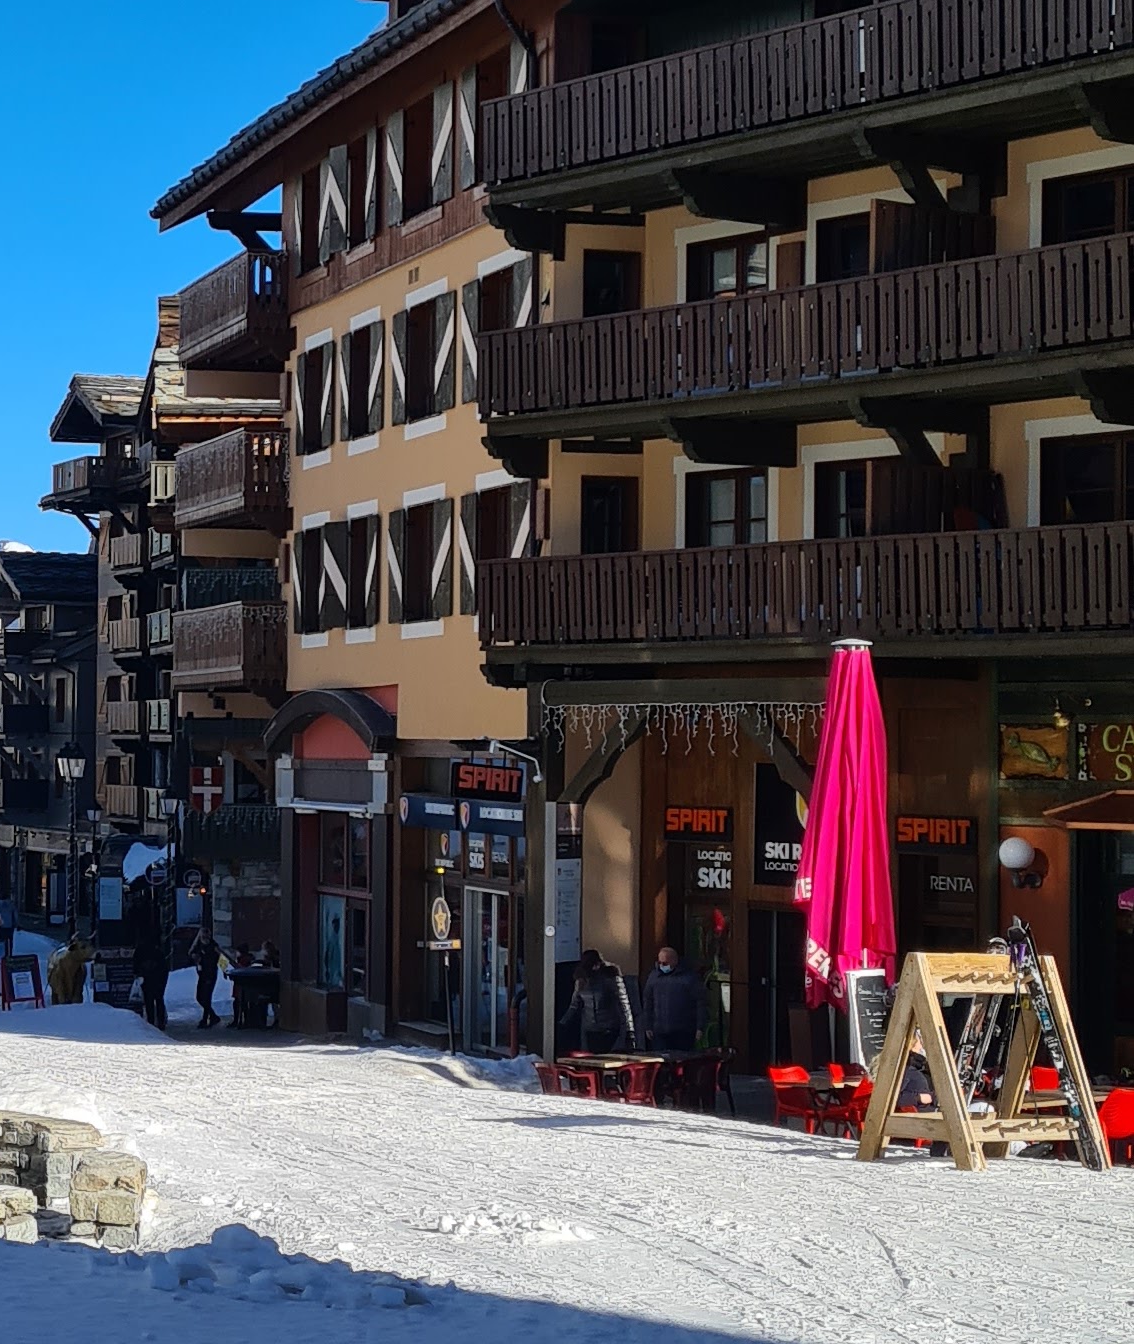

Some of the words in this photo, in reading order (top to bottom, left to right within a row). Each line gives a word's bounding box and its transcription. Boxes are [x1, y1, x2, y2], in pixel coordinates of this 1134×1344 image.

[1102, 724, 1134, 753] CA
[458, 765, 522, 793] SPIRIT
[666, 808, 728, 833] SPIRIT
[897, 817, 971, 845] SPIRIT
[697, 849, 732, 862] LOCATIO
[764, 841, 790, 860] SKI
[764, 861, 799, 872] LOCATIO
[929, 875, 974, 893] RENTA
